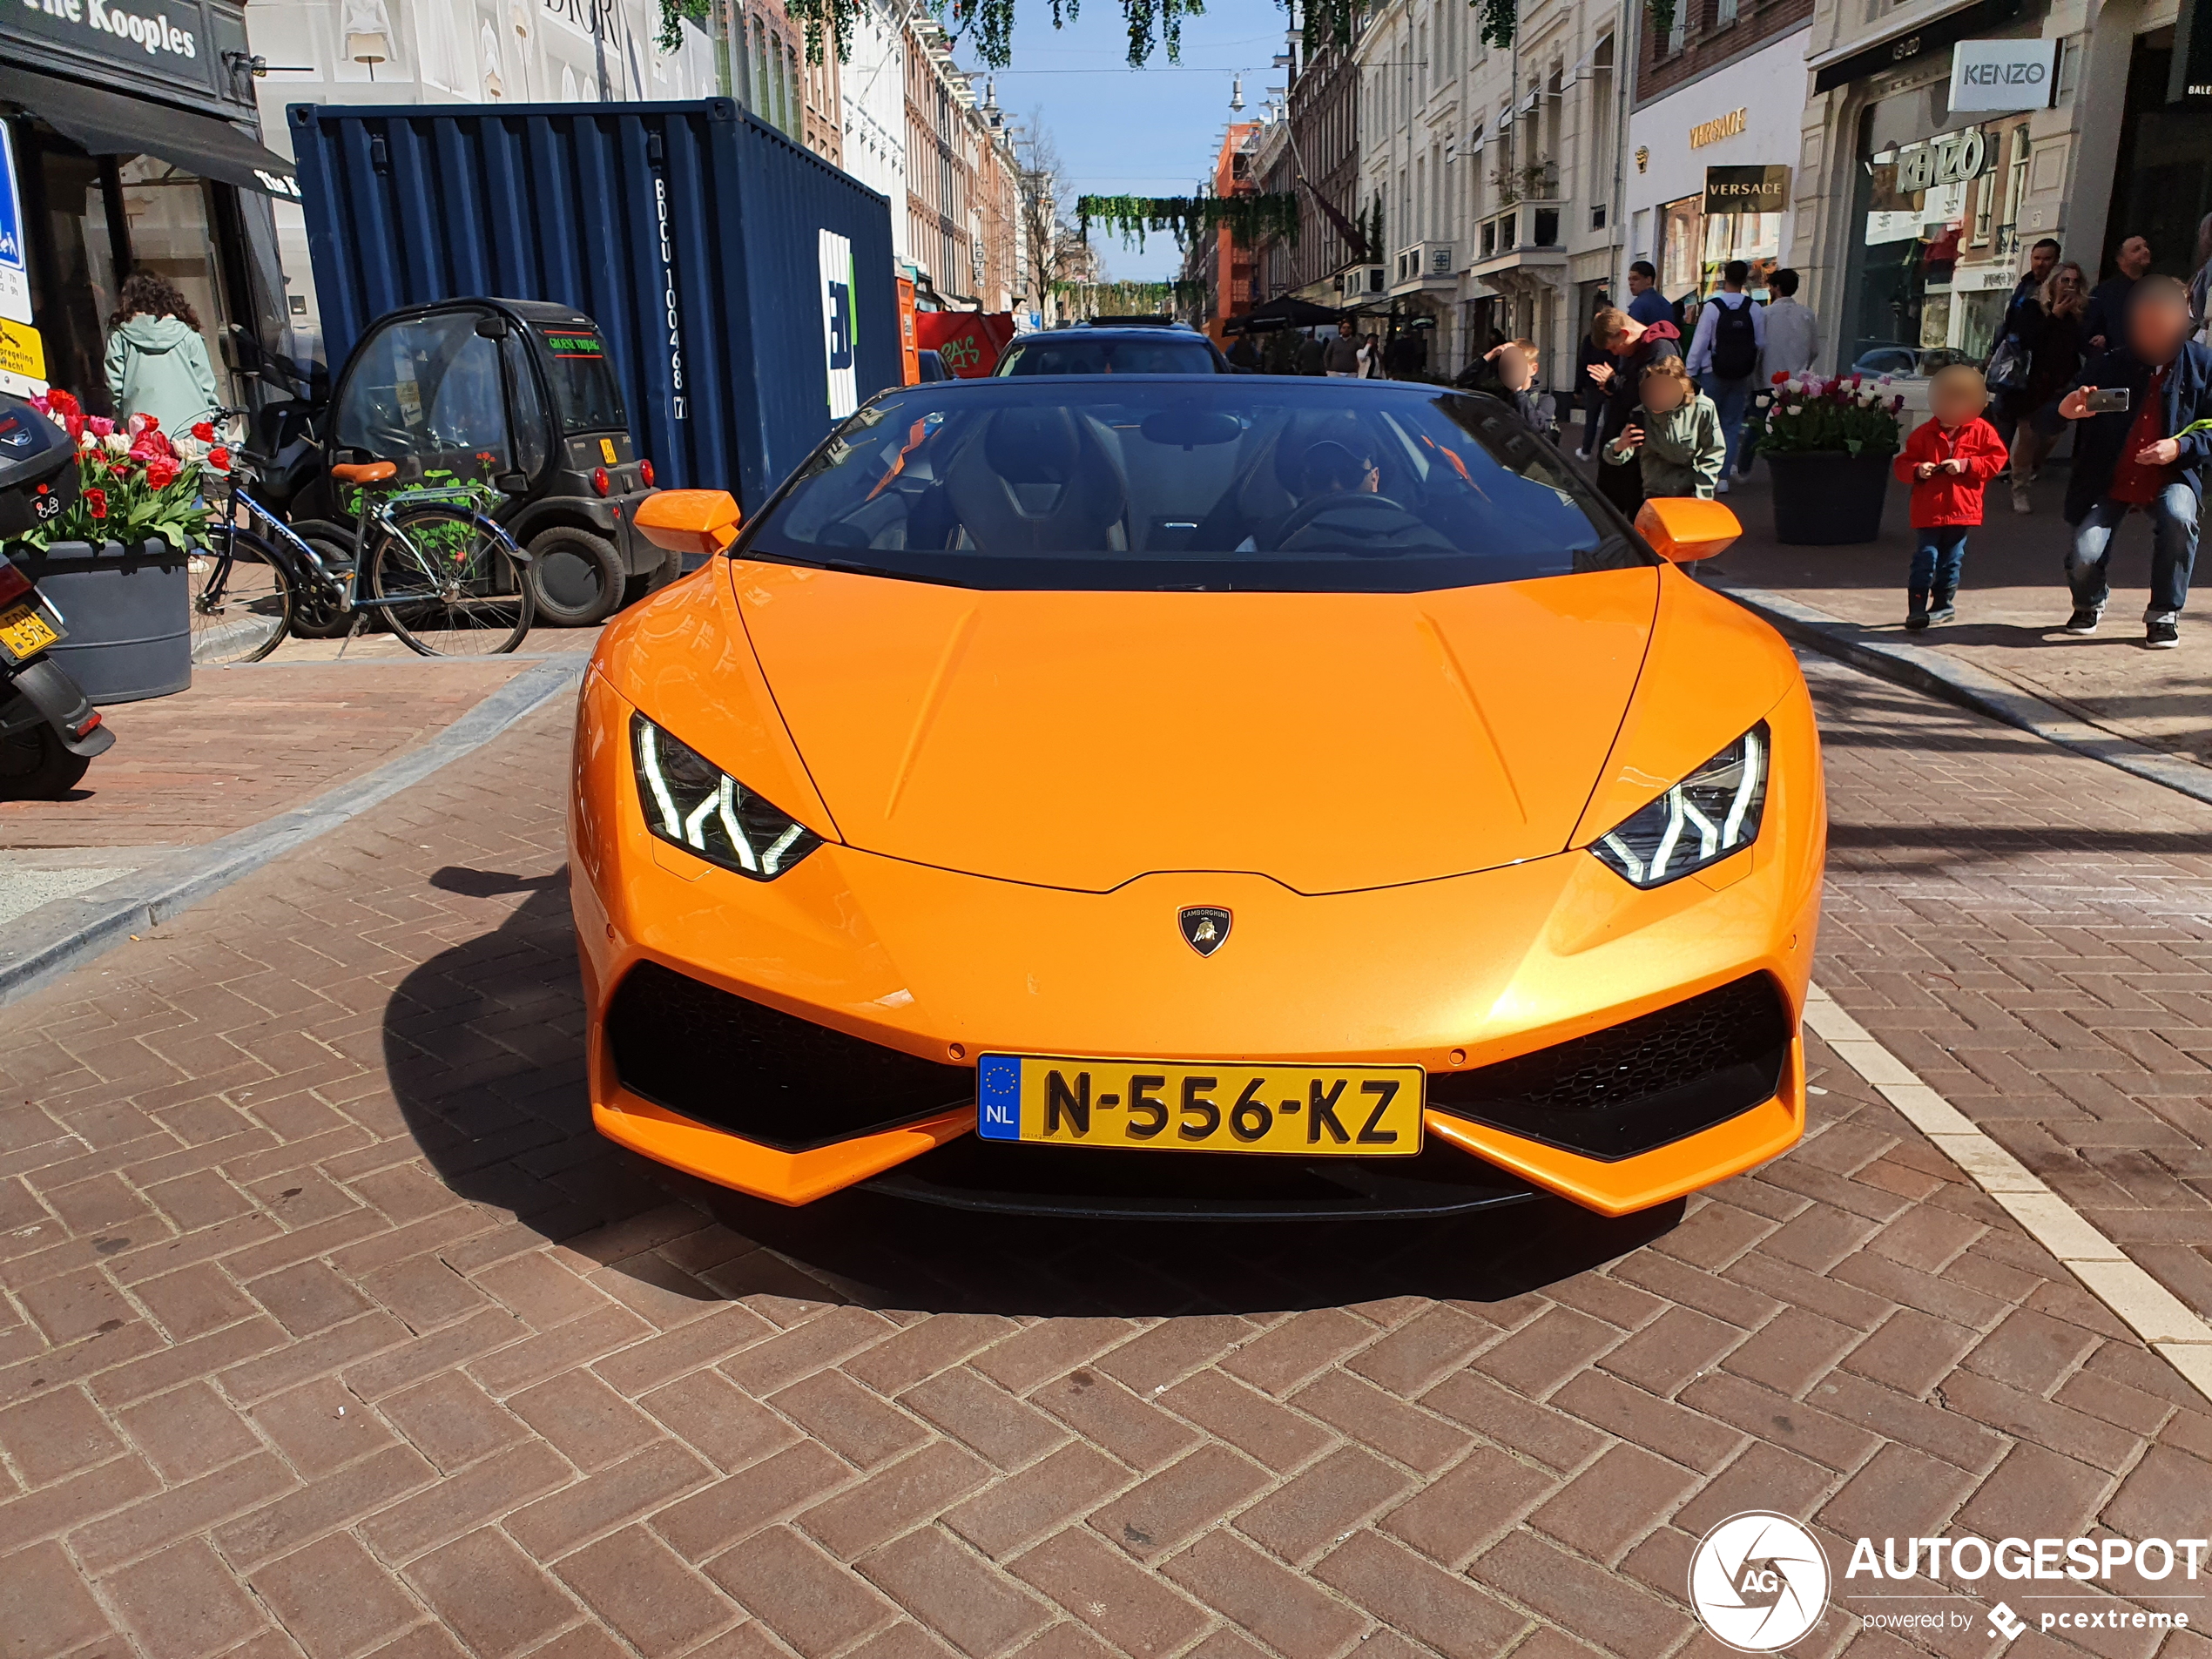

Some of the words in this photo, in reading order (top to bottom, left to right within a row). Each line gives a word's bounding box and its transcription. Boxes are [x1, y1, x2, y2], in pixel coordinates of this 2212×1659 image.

[24, 0, 83, 24] he
[89, 0, 196, 58] Kooples
[1964, 63, 2046, 85] KENZO
[1689, 106, 1747, 150] VERSACE
[1896, 132, 1985, 193] KENZO
[253, 169, 289, 194] The
[1710, 183, 1783, 196] VERSACE
[975, 240, 987, 287] HOTEL
[655, 179, 671, 263] BDCU
[665, 268, 683, 390] 100468
[20, 624, 52, 646] 57R
[1183, 909, 1228, 919] LAMBORGHINI
[987, 1104, 1014, 1124] NL
[1044, 1069, 1400, 1145] N-556-KZ
